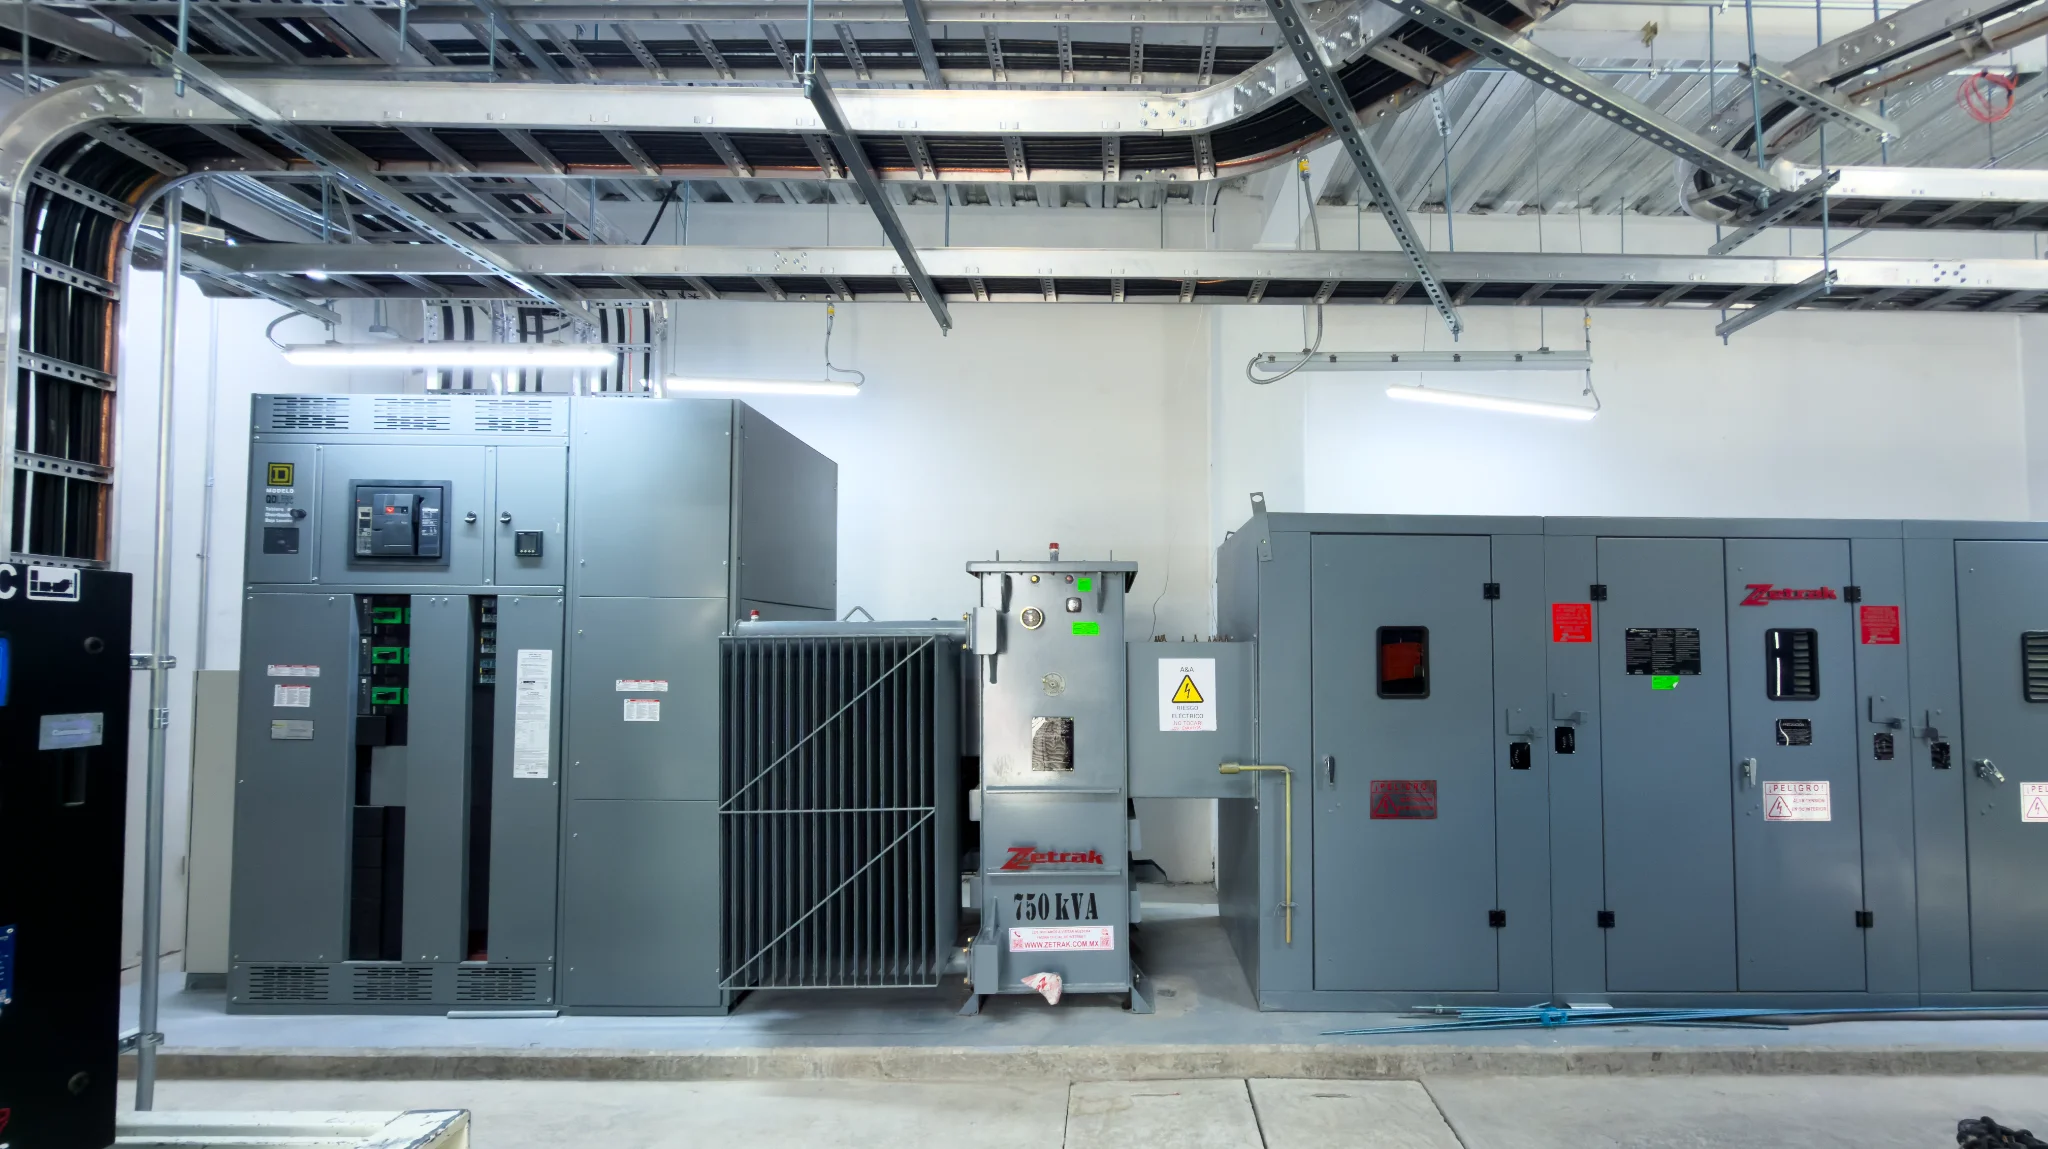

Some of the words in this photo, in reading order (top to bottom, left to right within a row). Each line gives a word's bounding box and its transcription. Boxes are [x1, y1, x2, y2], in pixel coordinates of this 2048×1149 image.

[1740, 583, 1837, 606] Zetrak
[1769, 784, 1824, 793] ¡PELIGRO!
[1000, 846, 1104, 870] Zetrak
[1014, 892, 1050, 920] 750
[1055, 892, 1099, 920] kVA
[1024, 940, 1099, 949] WWW.ZETRAK.COM.MX
